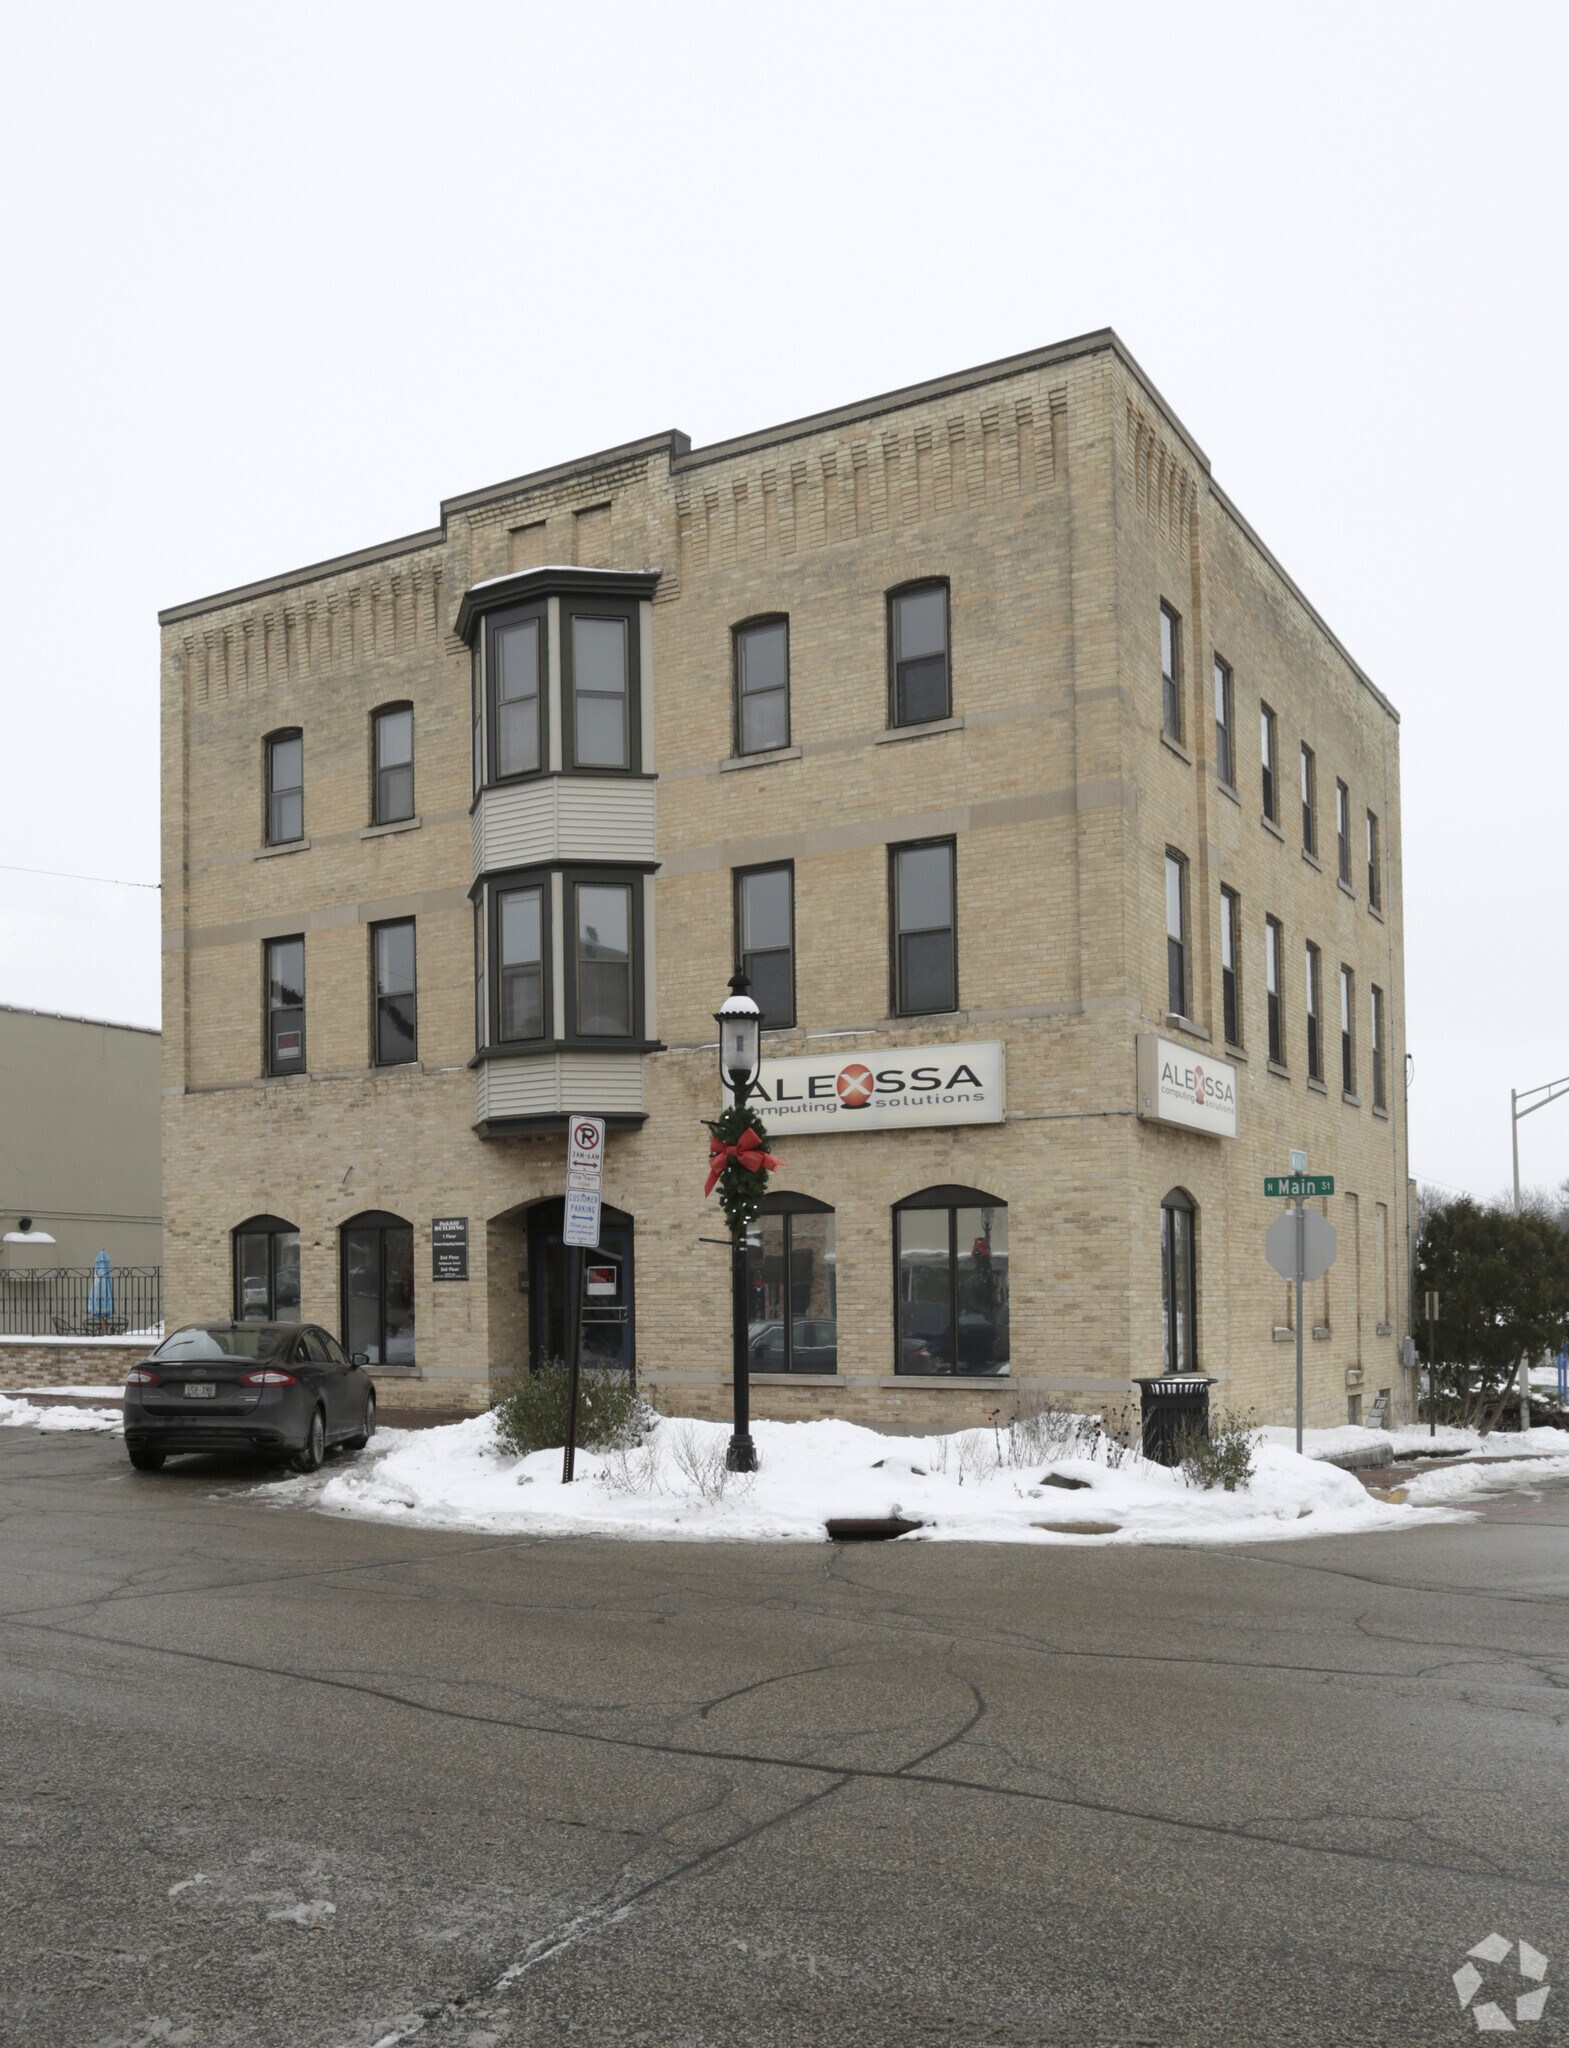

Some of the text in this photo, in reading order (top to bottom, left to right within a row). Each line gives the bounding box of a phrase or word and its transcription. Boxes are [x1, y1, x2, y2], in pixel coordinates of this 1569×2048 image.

[752, 1092, 985, 1117] omputing solutions
[1161, 1086, 1235, 1115] computing solutions
[1267, 1178, 1331, 1195] N Main St
[569, 1193, 598, 1204] CUSTOMER
[570, 1204, 596, 1214] PARKING
